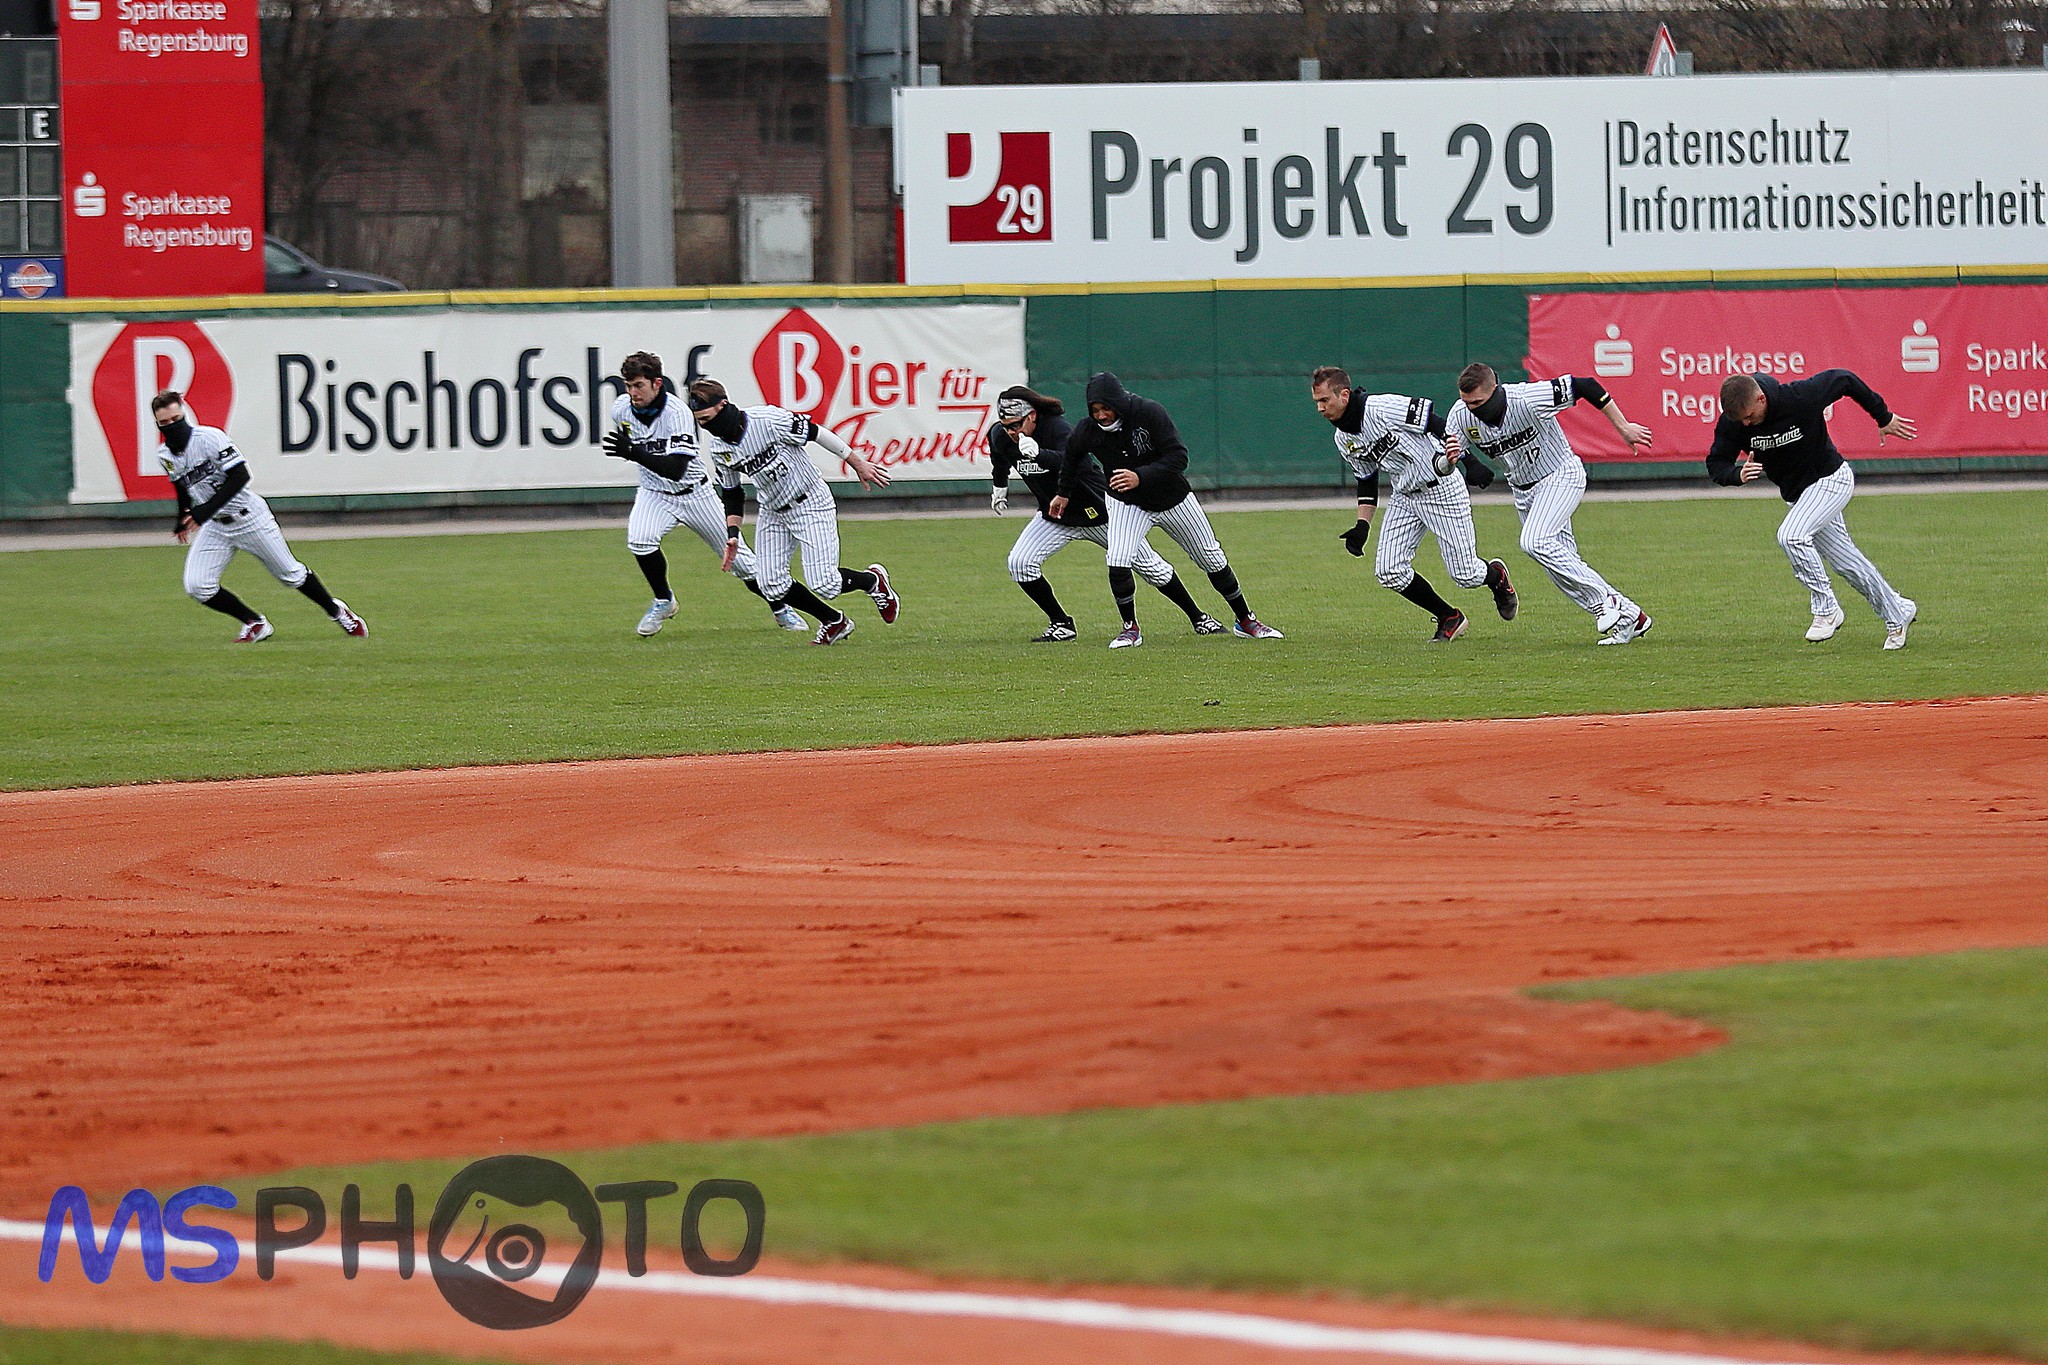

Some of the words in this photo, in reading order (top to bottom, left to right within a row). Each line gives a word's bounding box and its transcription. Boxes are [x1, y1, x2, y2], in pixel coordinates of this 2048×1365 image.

[117, 0, 227, 24] Sparkasse
[118, 27, 249, 57] Regensburg
[1617, 119, 1851, 168] Datenschutz
[122, 191, 232, 220] Sparkasse
[996, 184, 1045, 234] 29
[1090, 127, 1408, 262] Projekt
[1447, 122, 1554, 236] 29
[1618, 178, 2047, 232] Informationssicherheit
[124, 223, 254, 252] Regensburg
[1660, 346, 1806, 382] Sparkasse
[1966, 341, 2048, 378] Spark
[278, 344, 713, 454] Bischofshf
[940, 369, 987, 399] für
